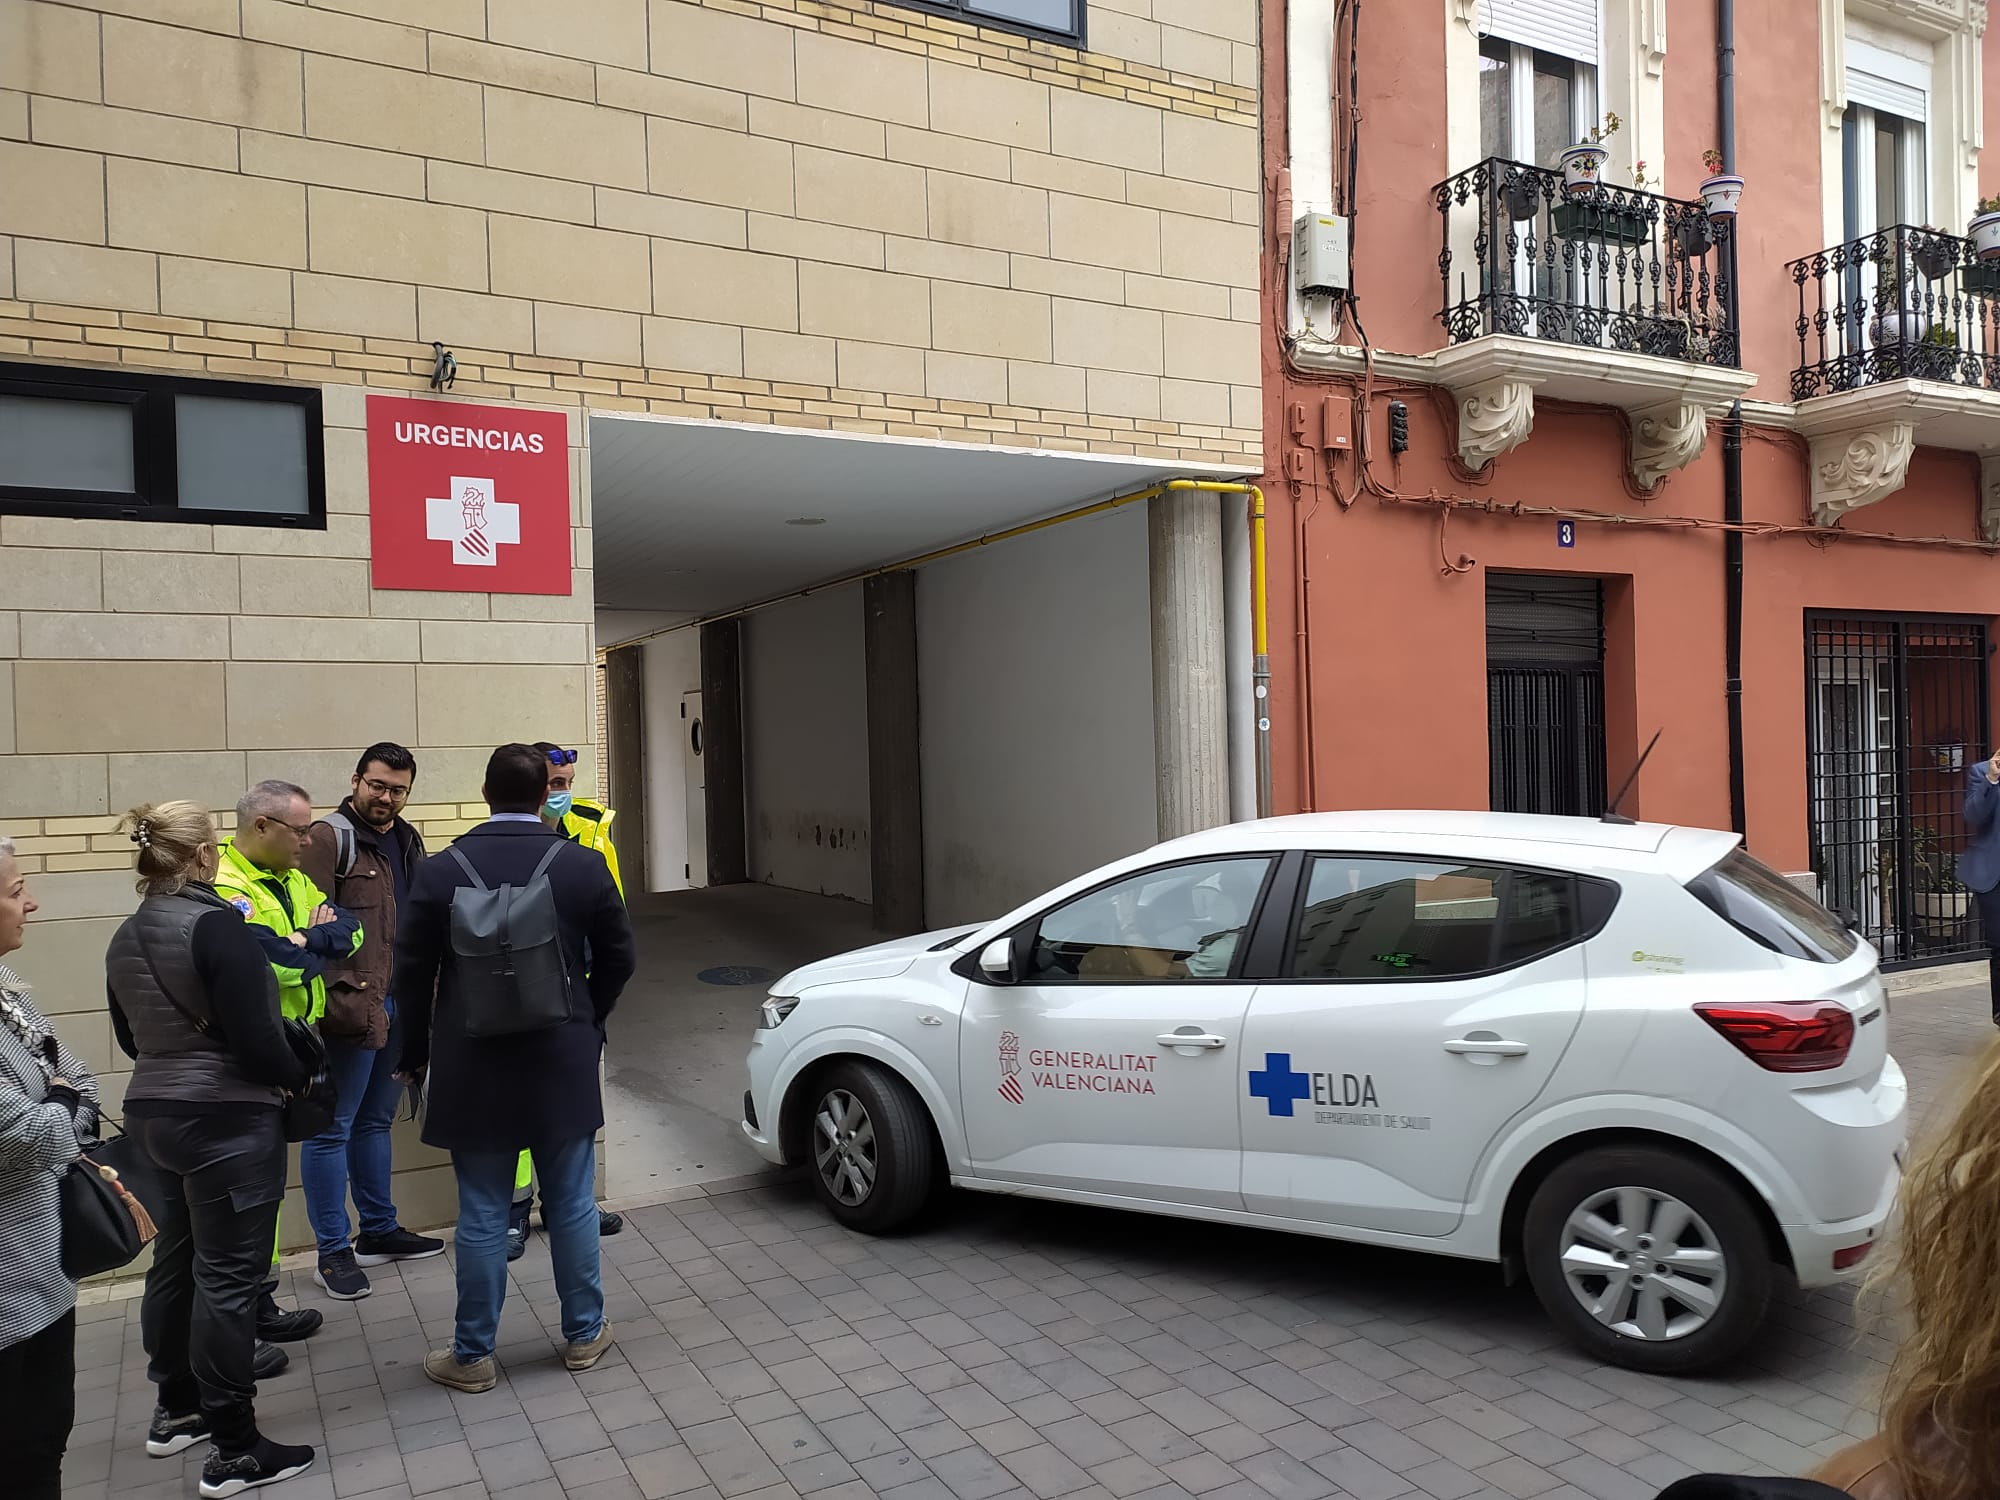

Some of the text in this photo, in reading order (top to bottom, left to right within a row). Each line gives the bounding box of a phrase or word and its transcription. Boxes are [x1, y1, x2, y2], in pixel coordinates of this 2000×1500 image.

[394, 421, 544, 454] URGENCIAS
[1562, 524, 1571, 544] 3
[1029, 1049, 1158, 1073] GENERALITAT
[1031, 1071, 1156, 1096] VALENCIANA
[1312, 1072, 1379, 1108] ELDA
